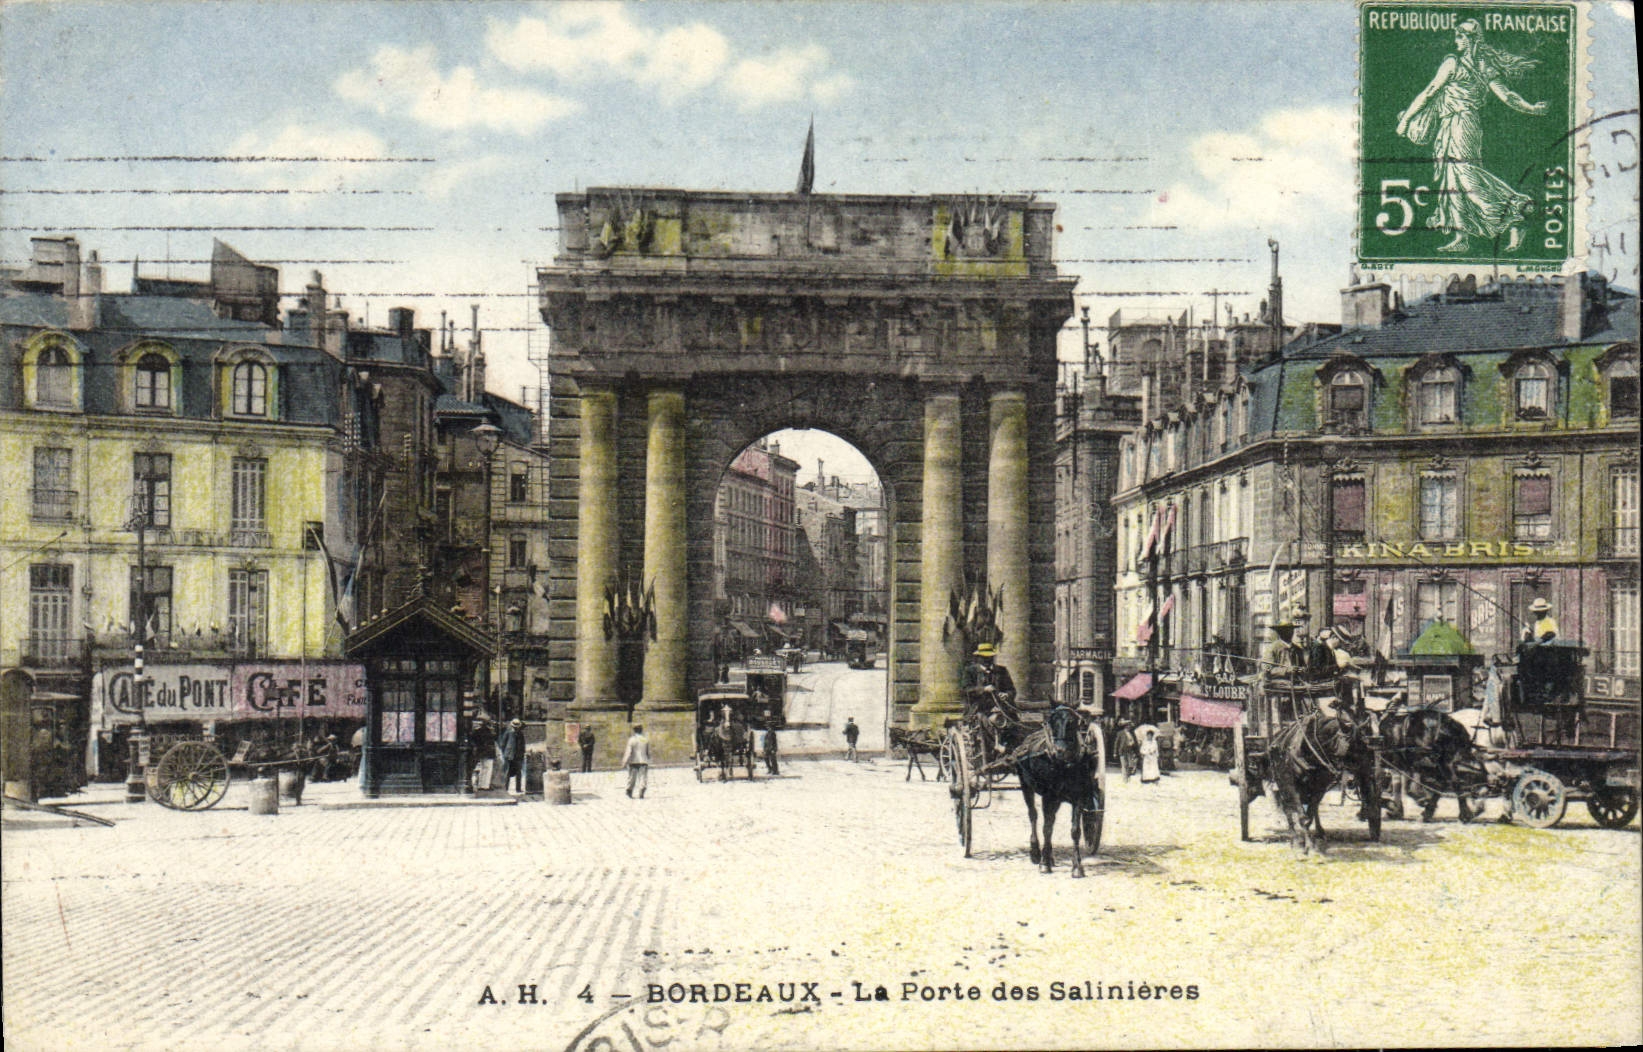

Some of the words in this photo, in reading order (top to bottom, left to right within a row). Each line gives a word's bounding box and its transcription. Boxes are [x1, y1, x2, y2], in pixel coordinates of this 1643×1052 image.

[1484, 13, 1568, 35] FRANÇAISE
[1544, 164, 1565, 250] POSTES
[1343, 540, 1535, 559] KINA-BRIS
[109, 671, 155, 715] CAÉ
[156, 682, 177, 708] du
[179, 674, 228, 711] PONT
